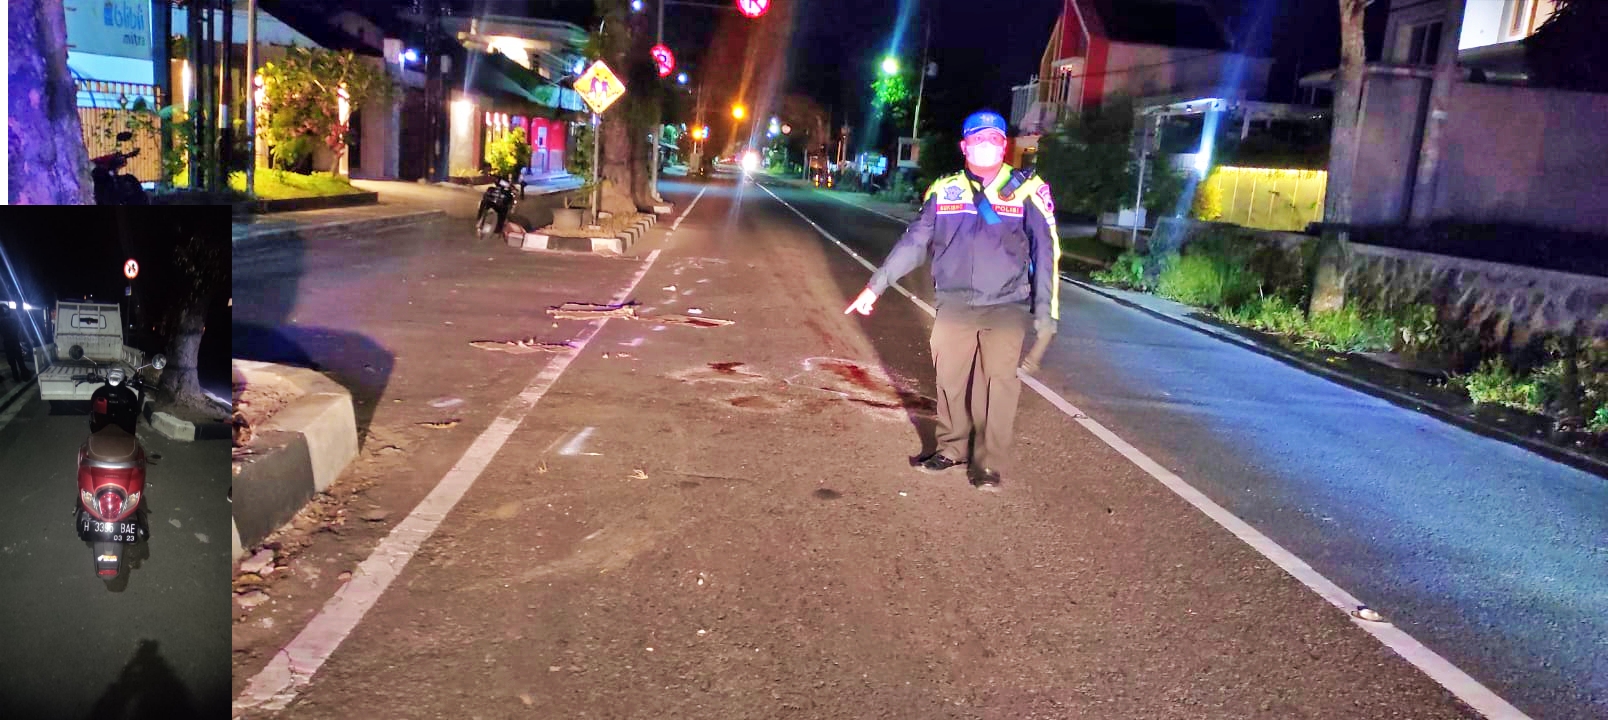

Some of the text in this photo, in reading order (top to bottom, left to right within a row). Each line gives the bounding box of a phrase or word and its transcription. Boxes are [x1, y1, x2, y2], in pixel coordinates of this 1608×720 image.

[123, 34, 145, 46] mitra
[995, 205, 1019, 213] POLISI
[84, 522, 90, 531] H
[121, 523, 136, 534] BAE
